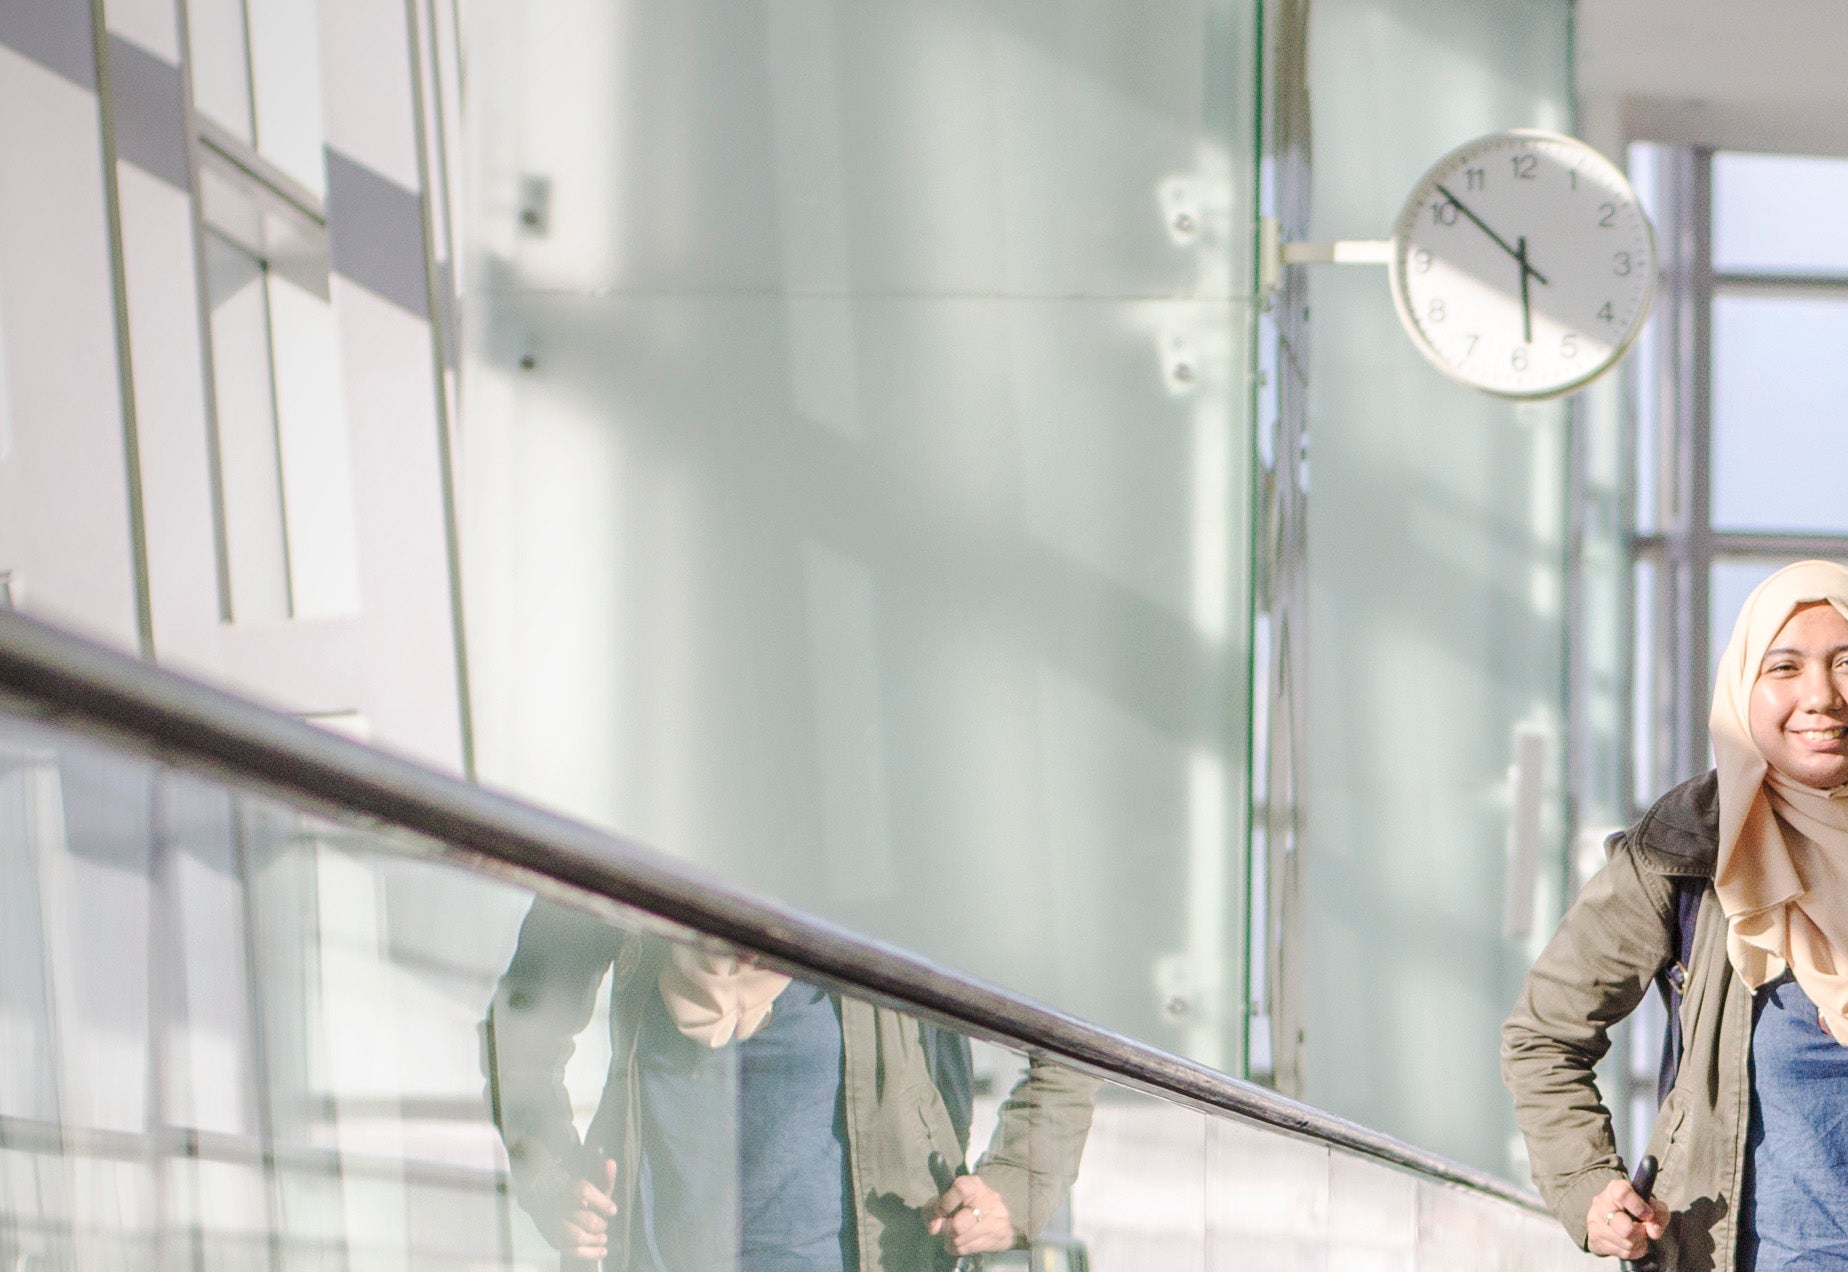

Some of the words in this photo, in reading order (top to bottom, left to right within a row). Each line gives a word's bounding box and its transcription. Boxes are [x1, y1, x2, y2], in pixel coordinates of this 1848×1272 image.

[1465, 168, 1486, 191] 11
[1511, 154, 1538, 181] 12
[1568, 168, 1579, 191] 1
[1432, 201, 1460, 227] 10
[1599, 202, 1616, 228] 2
[1415, 250, 1433, 274] 9
[1613, 251, 1632, 277] 3
[1427, 299, 1447, 323] 8
[1597, 300, 1614, 323] 4
[1459, 334, 1479, 357] 7
[1560, 334, 1578, 359] 5
[1510, 347, 1529, 372] 6
